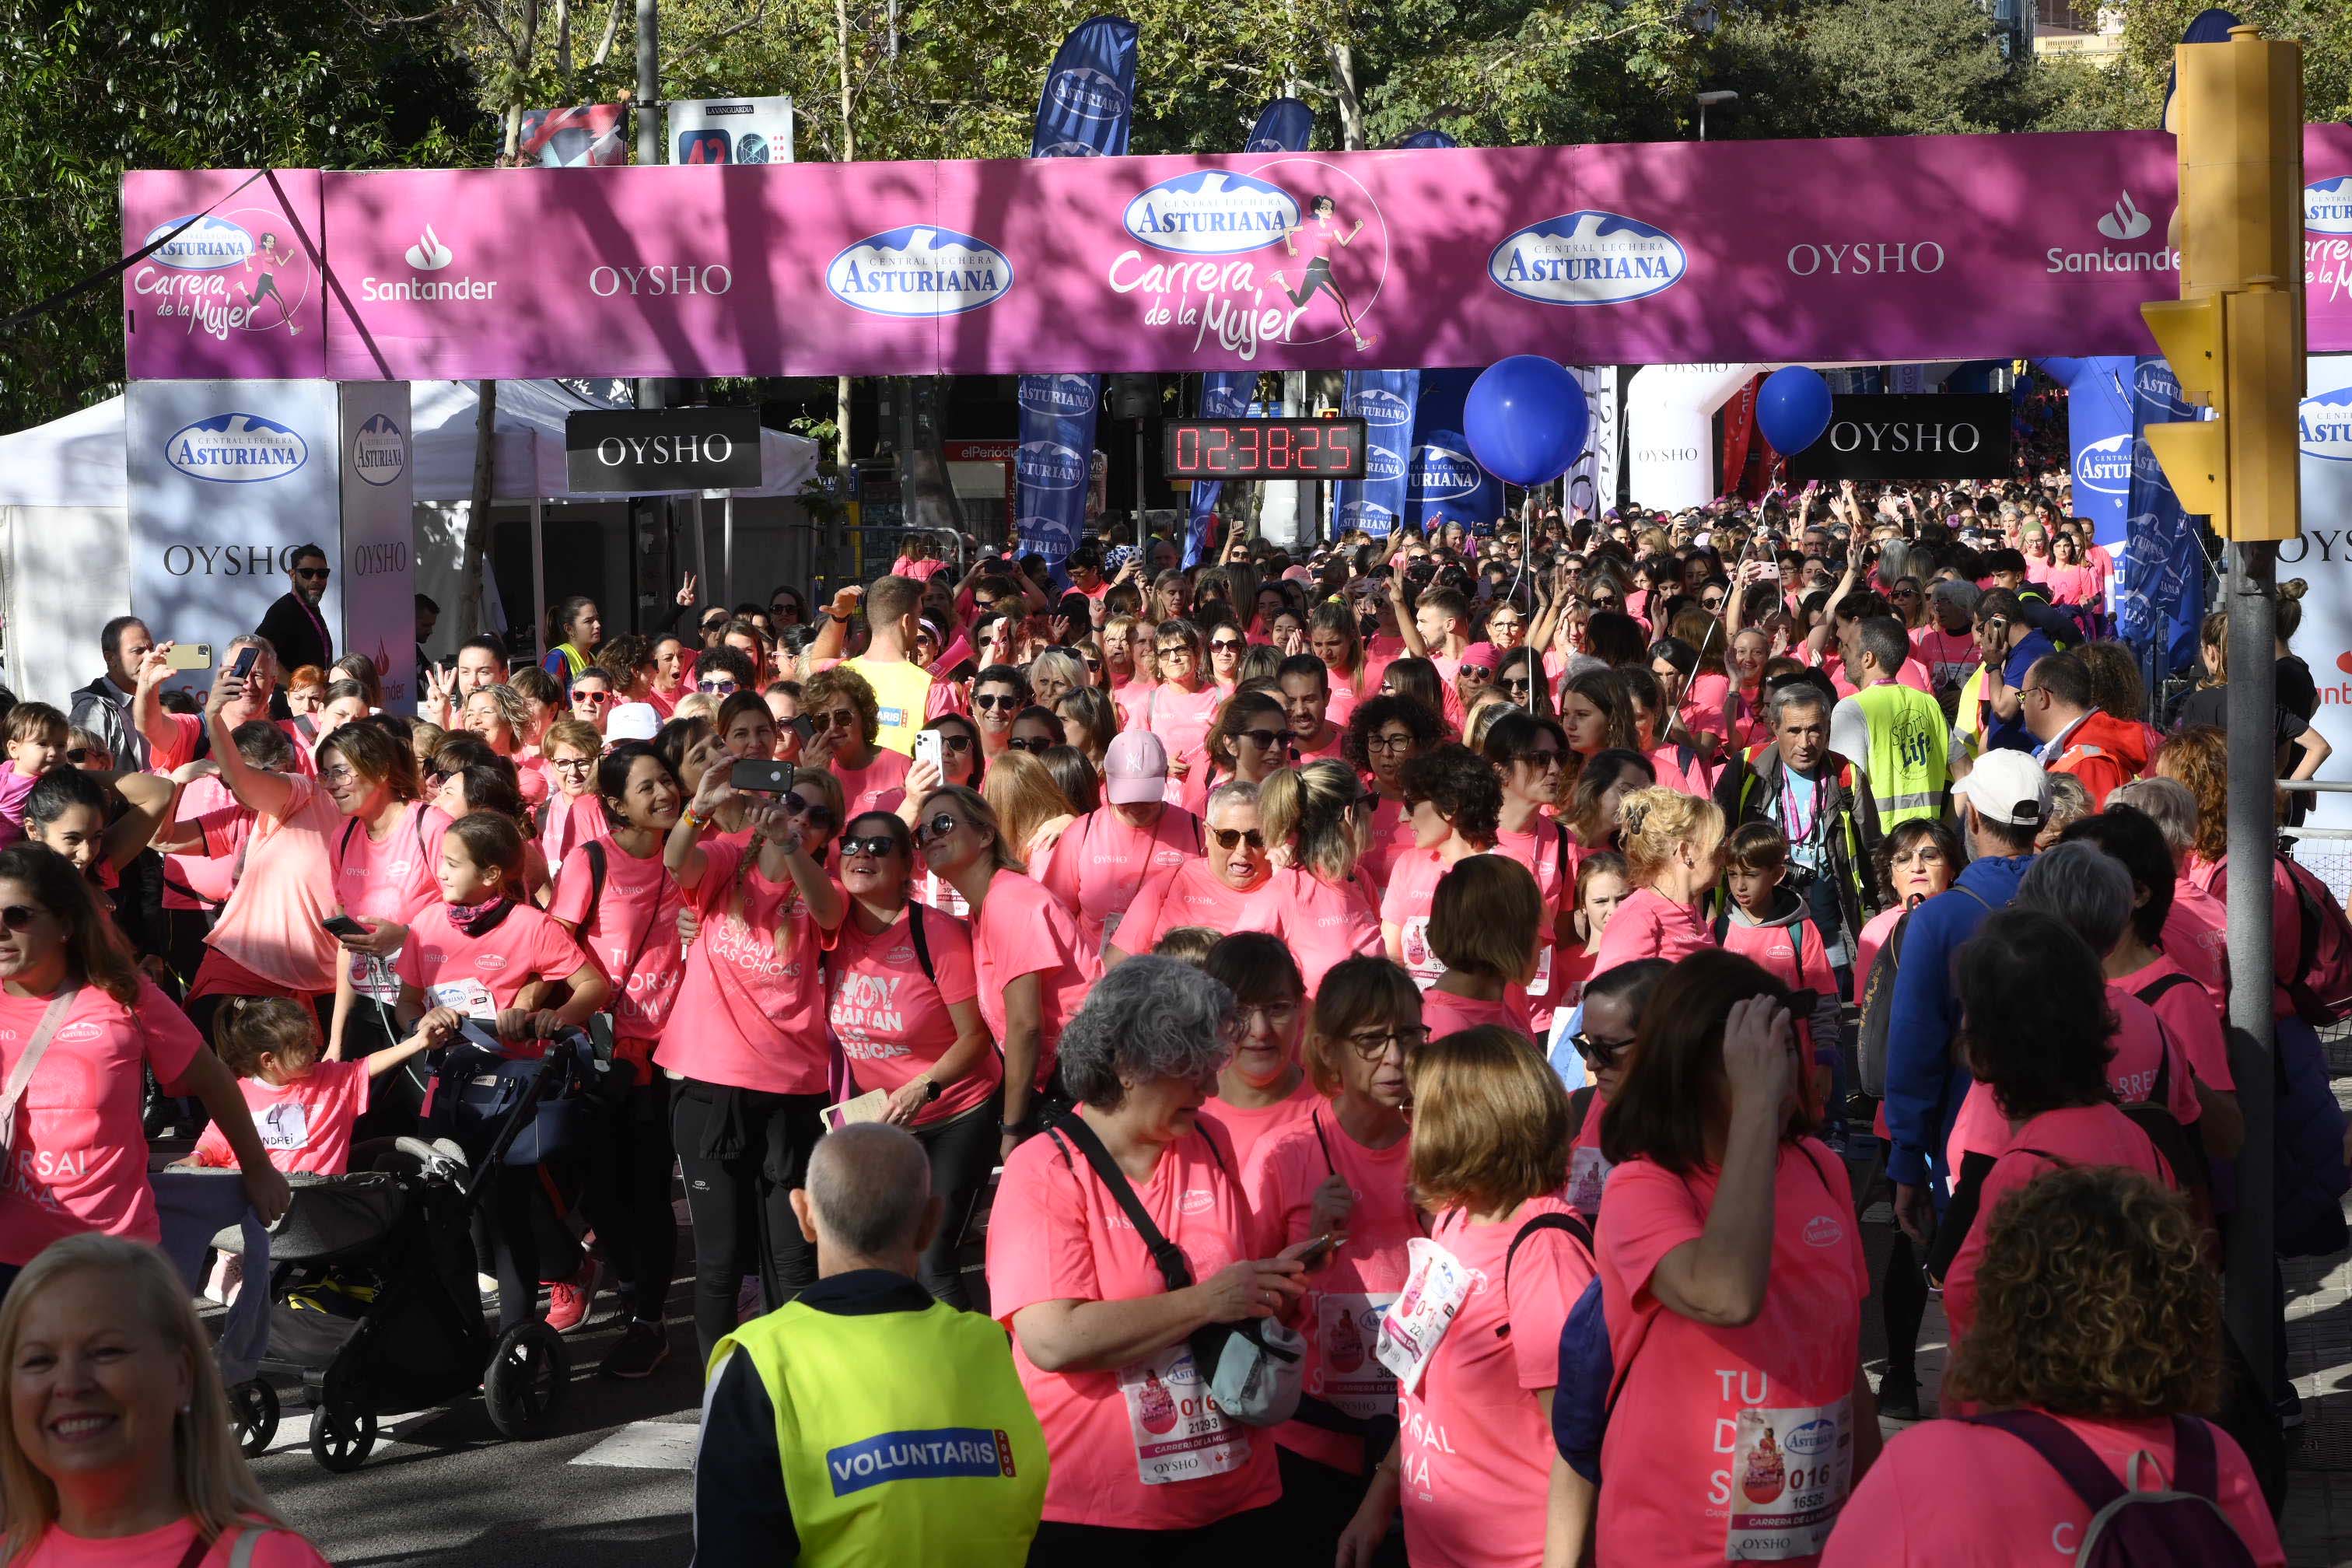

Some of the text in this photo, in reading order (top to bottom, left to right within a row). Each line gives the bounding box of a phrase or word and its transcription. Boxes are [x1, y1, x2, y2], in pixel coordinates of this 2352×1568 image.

[1136, 201, 1285, 234] ASTURIANA
[869, 255, 992, 267] CENTRAL LECHERA
[1535, 243, 1664, 254] CENTRAL LECHERA
[1788, 241, 1945, 275] OYSHO
[2046, 246, 2180, 273] Santande
[840, 260, 999, 293] ASTURIANA
[1108, 250, 1255, 294] Carrera
[1503, 247, 1671, 282] ASTURIANA
[134, 266, 229, 295] Carrera
[361, 276, 498, 303] Santander
[590, 265, 733, 296] OYSHO
[156, 290, 261, 341] de la Mujer
[1145, 287, 1309, 361] de la Mujer
[1019, 380, 1090, 408] ASTURIANA
[1349, 401, 1405, 421] ASTURIANA
[597, 433, 733, 467] OYSHO
[1177, 427, 1350, 471] 02:38:25
[1829, 422, 1980, 453] OYSHO
[177, 439, 298, 465] ASTURIANA
[357, 436, 402, 468] ASTURIANA
[1639, 448, 1698, 462] OYSHO
[1018, 462, 1081, 481] STURIANA
[1367, 462, 1400, 474] RIANA
[1410, 472, 1474, 488] URIANA
[2082, 456, 2131, 479] ASTU
[354, 541, 407, 576] OYSHO
[1892, 713, 1925, 747] Sport
[1125, 752, 1143, 772] NY
[610, 947, 635, 968] TU
[712, 939, 802, 977] LAS CHICAS
[831, 968, 901, 1010] HOY
[266, 1105, 281, 1132] 4
[1715, 1369, 1768, 1405] TU
[1188, 1417, 1219, 1435] 21293
[833, 1440, 996, 1481] VOLUNTARIS
[1154, 1440, 1194, 1454] CARRERA
[1153, 1458, 1199, 1475] OYSHO
[1790, 1464, 1830, 1490] 016
[1792, 1492, 1825, 1510] 16526
[1748, 1517, 1792, 1528] CARRERA
[1741, 1538, 1791, 1550] OYSHO
